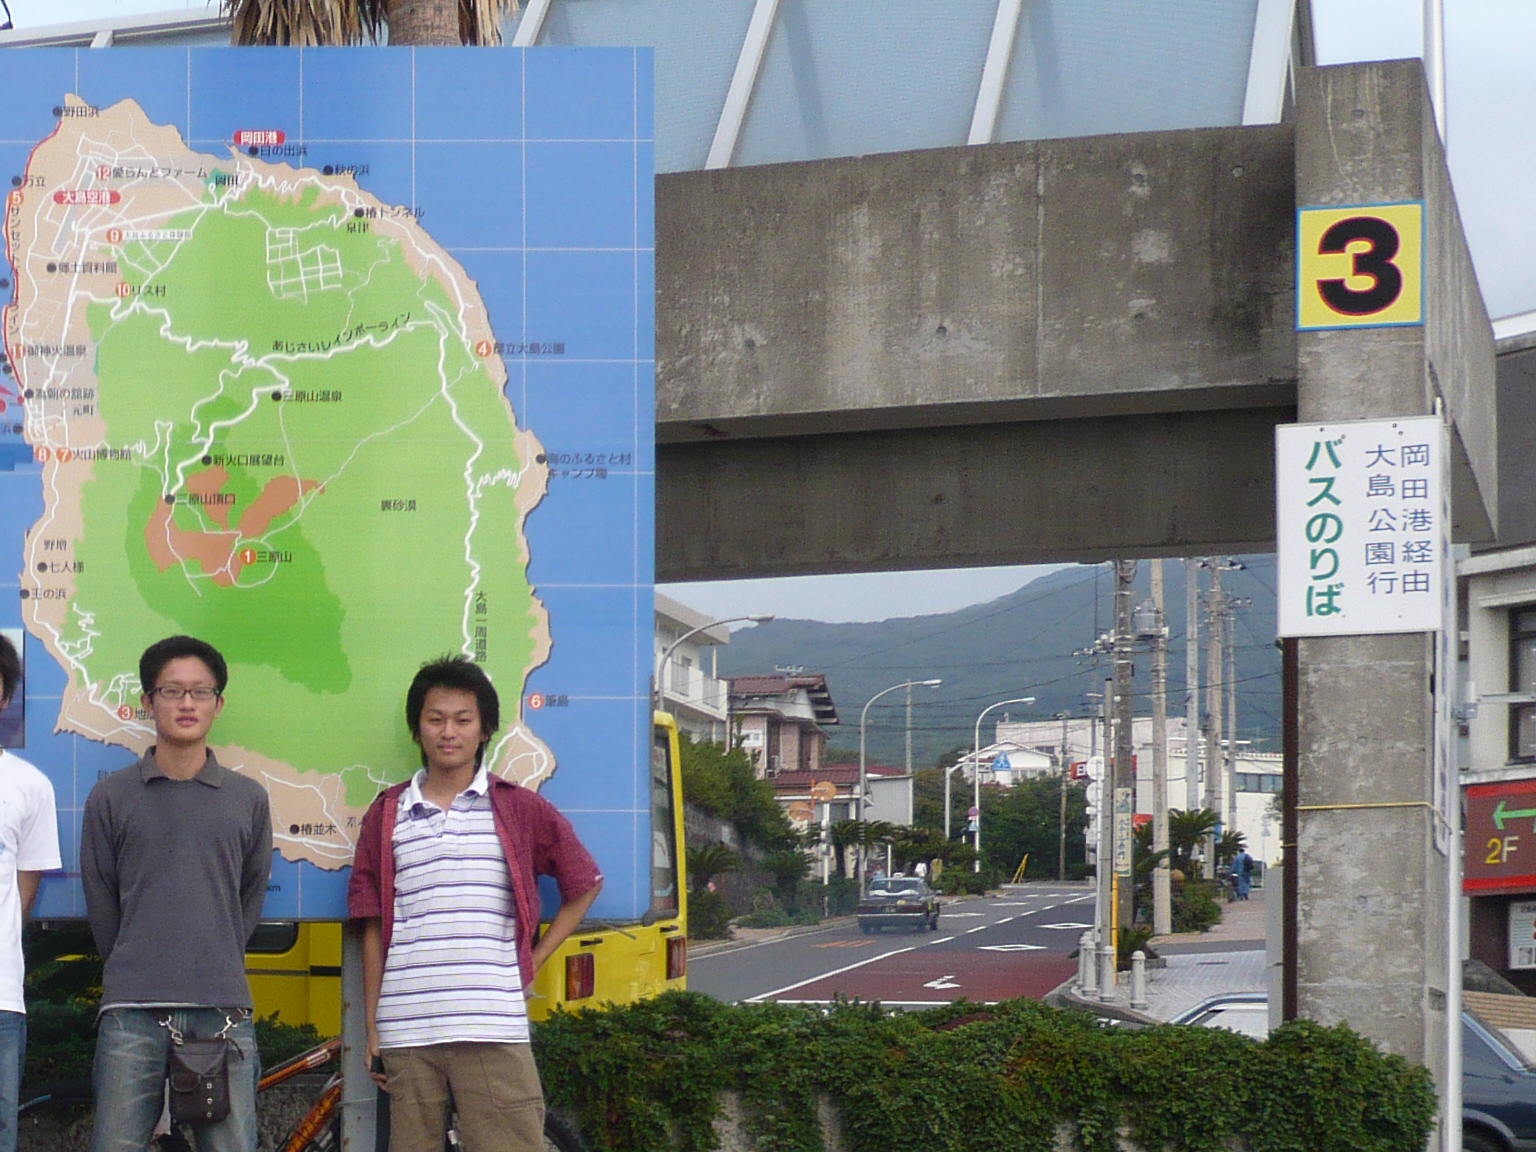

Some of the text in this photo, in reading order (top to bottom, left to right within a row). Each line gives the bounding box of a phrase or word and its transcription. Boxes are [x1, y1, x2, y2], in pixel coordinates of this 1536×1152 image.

[240, 131, 279, 145] 岡田港
[112, 167, 207, 179] 愛らんどファーム
[63, 191, 111, 204] 大島空港
[365, 207, 425, 219] 椿トンネル
[1316, 216, 1403, 316] 3
[1305, 436, 1346, 617] バスのりば
[1365, 444, 1398, 595] 大島公園行
[1401, 443, 1433, 595] 岡田港経由
[256, 551, 292, 563] 三原山
[474, 590, 487, 662] 大島一周道路
[300, 823, 337, 836] 椿並木
[1485, 836, 1519, 864] 2F
